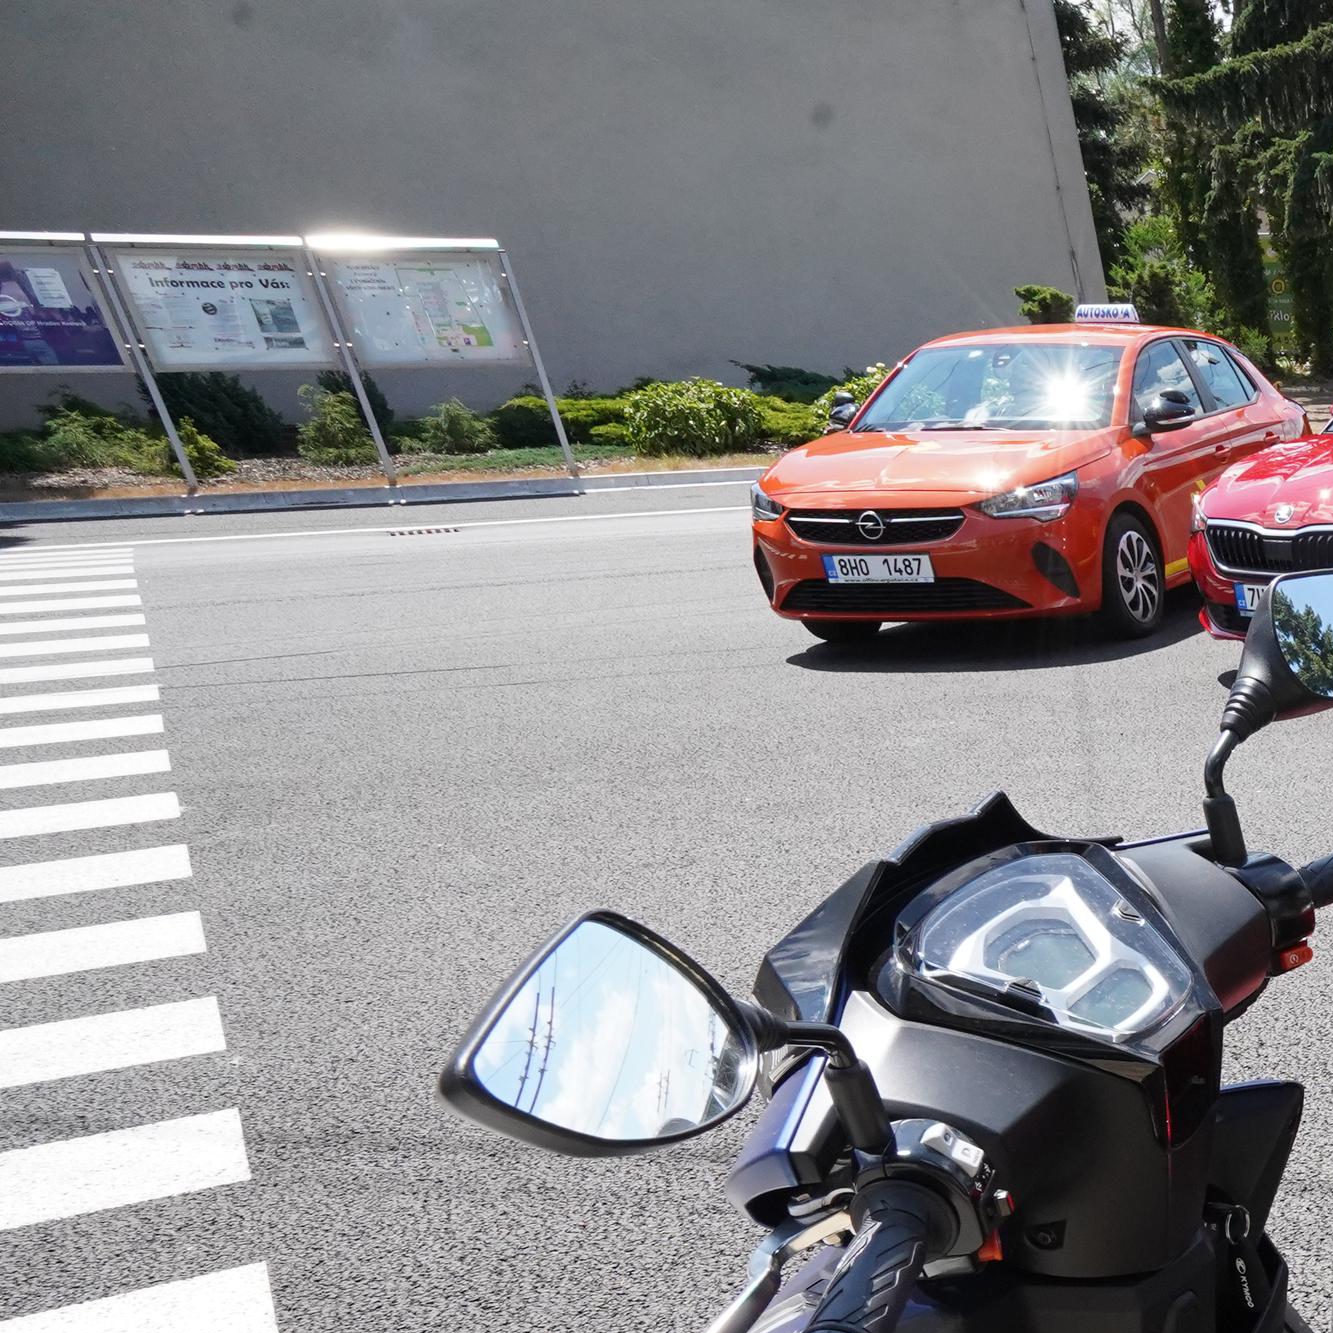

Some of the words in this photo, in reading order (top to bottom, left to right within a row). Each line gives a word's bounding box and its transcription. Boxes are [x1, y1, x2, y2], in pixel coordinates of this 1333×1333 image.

[149, 277, 225, 289] Informace
[229, 281, 254, 291] pro
[258, 278, 291, 289] Vás:
[882, 558, 922, 576] 1487
[1240, 1275, 1255, 1308] KYMCO
